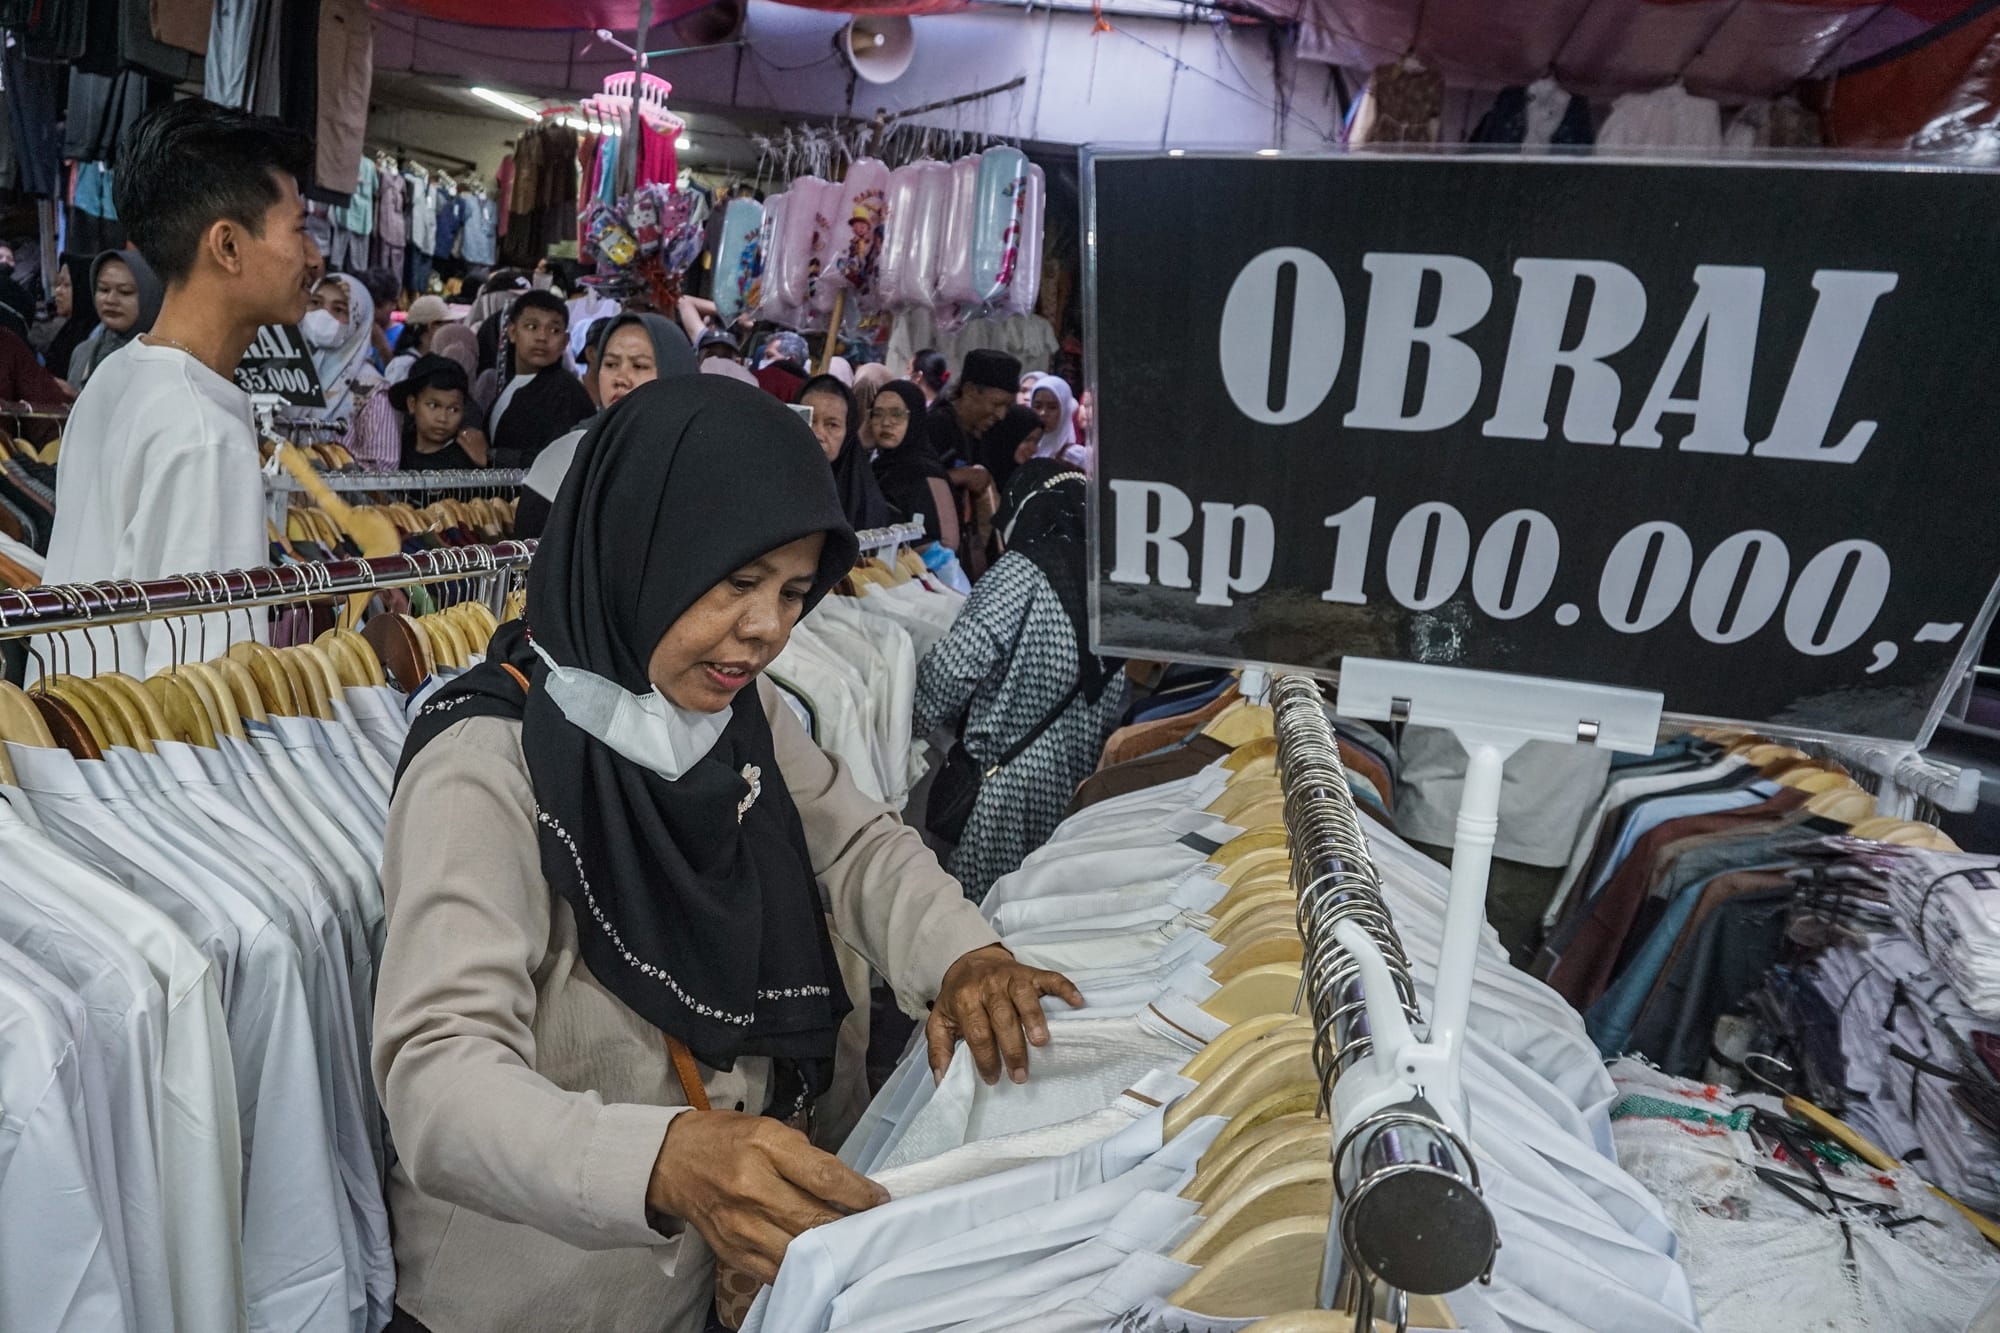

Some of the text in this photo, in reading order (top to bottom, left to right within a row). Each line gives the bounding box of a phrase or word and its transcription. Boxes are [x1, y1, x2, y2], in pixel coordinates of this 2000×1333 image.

[242, 324, 301, 358] AL
[1219, 246, 1899, 464] OBRAL
[1109, 479, 1964, 674] Rp 100.000,-
